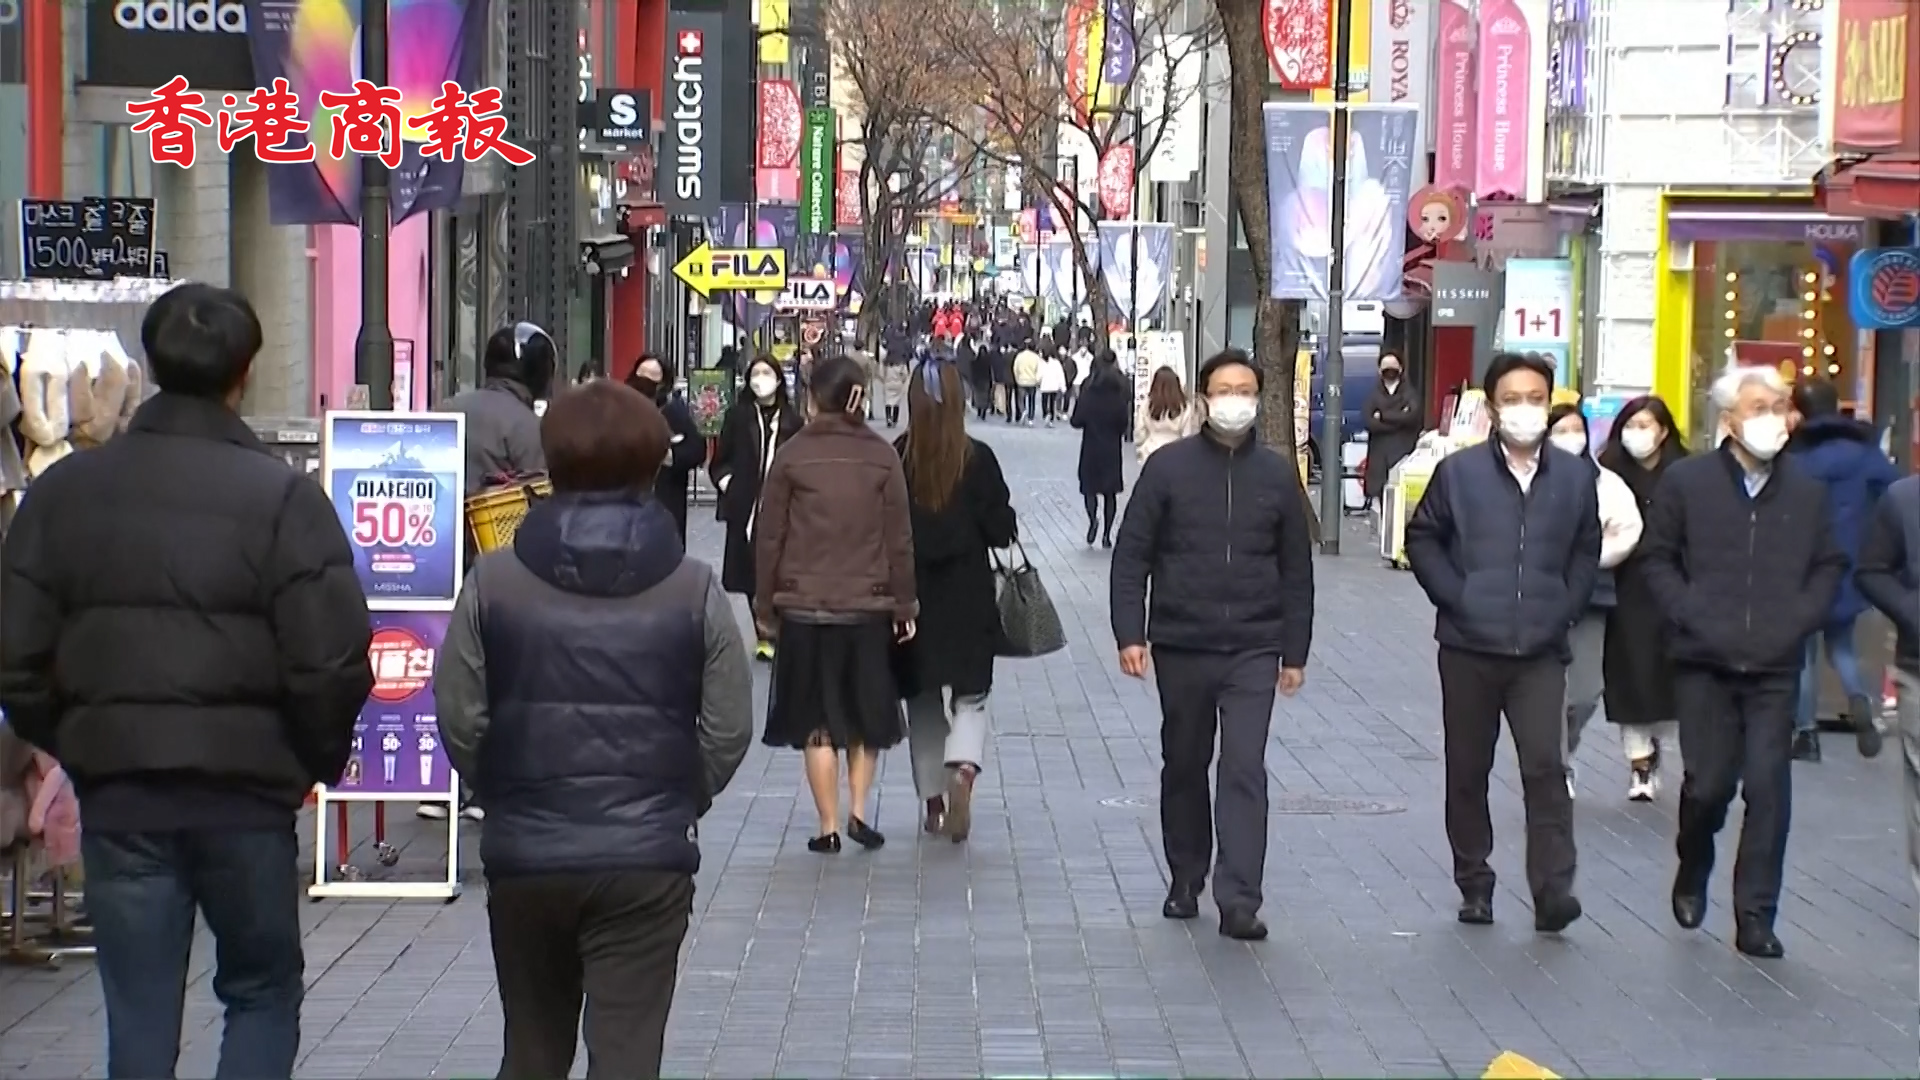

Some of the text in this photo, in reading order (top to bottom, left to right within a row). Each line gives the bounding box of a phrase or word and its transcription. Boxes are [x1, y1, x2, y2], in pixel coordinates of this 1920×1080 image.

[608, 93, 637, 126] S
[1451, 52, 1469, 169] Princess House
[1493, 45, 1513, 171] Princess House
[602, 127, 644, 139] market
[672, 55, 704, 201] swatch
[811, 125, 825, 170] Nature
[1805, 224, 1858, 239] HOLIKA
[711, 254, 780, 277] FILA
[778, 282, 830, 299] ILA
[1514, 307, 1562, 338] 1+1
[356, 480, 434, 500] 미샤데이
[355, 501, 434, 544] 50%
